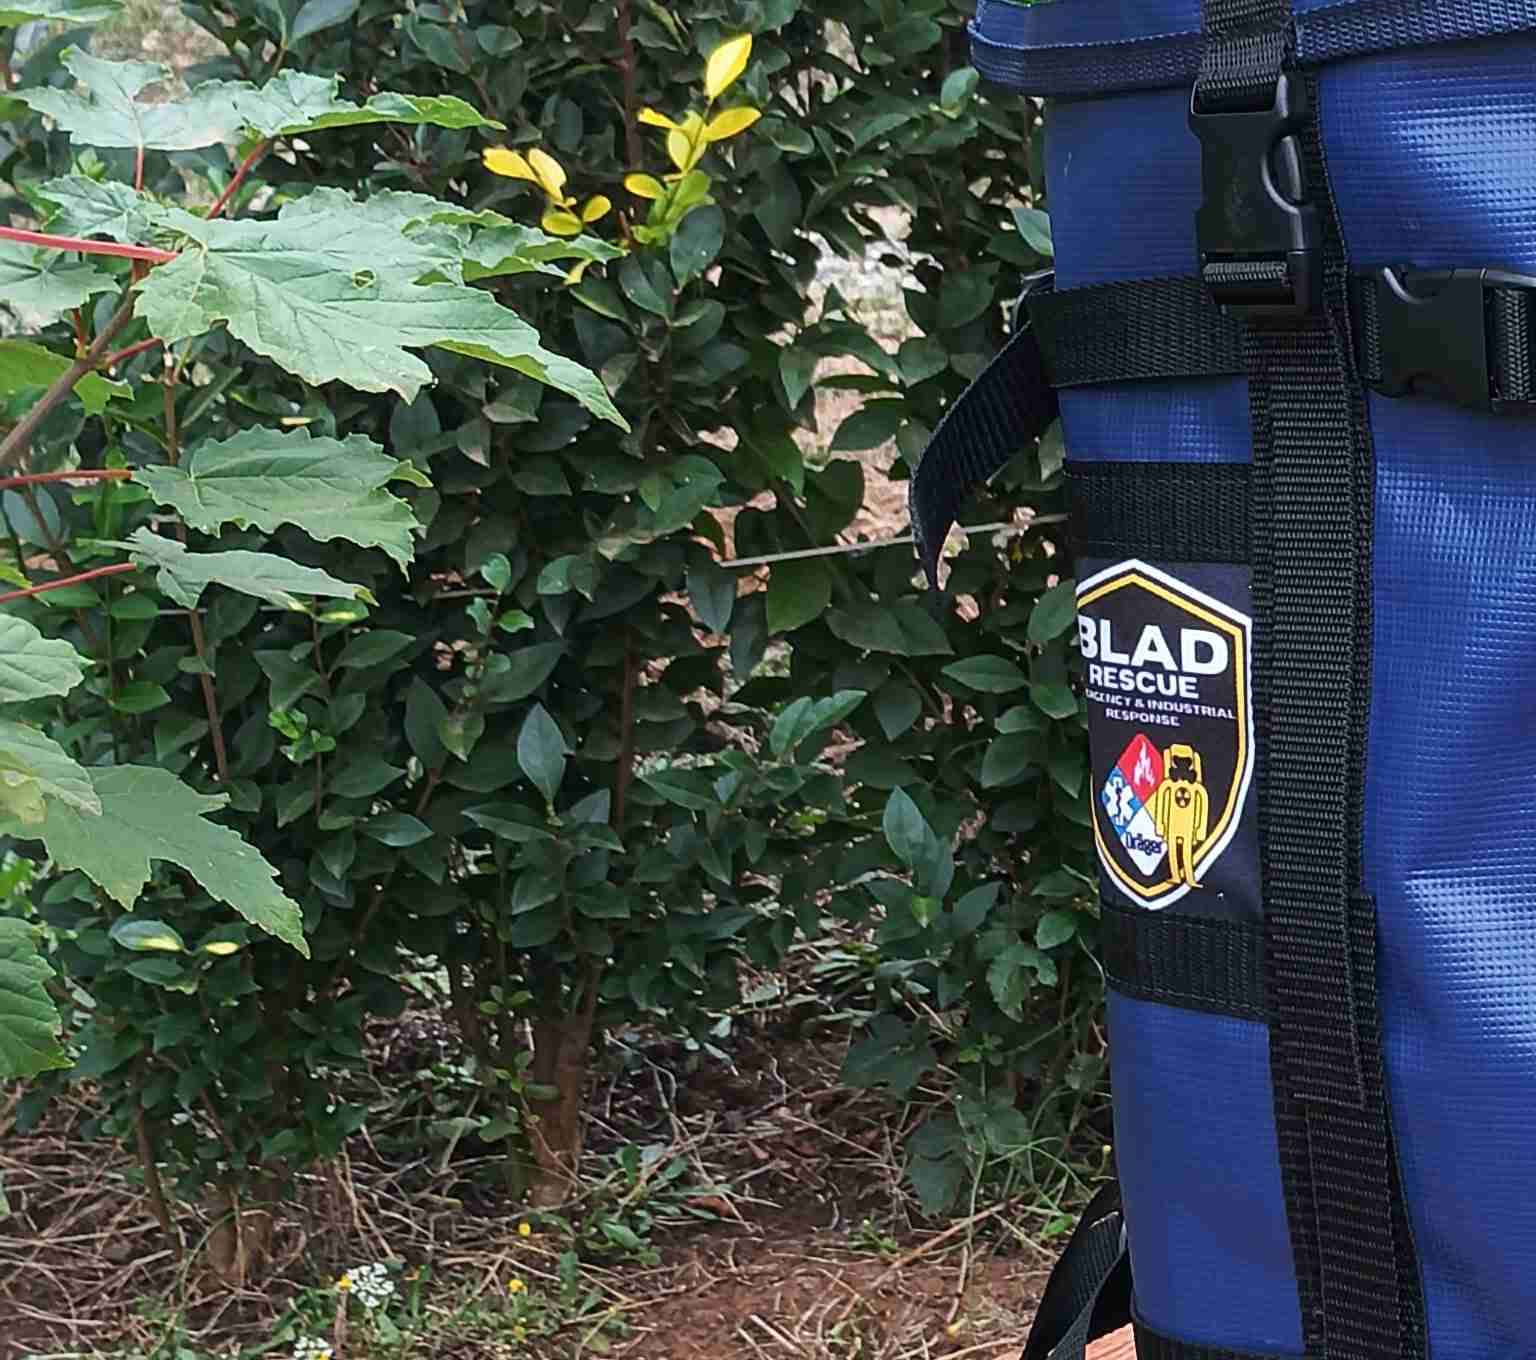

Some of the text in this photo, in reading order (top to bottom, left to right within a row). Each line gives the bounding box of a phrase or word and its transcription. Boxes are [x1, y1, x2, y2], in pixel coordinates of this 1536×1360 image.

[1089, 664, 1199, 699] RESCUE
[1105, 708, 1181, 727] RESPONSE
[1147, 700, 1237, 720] INDUSTRIAL
